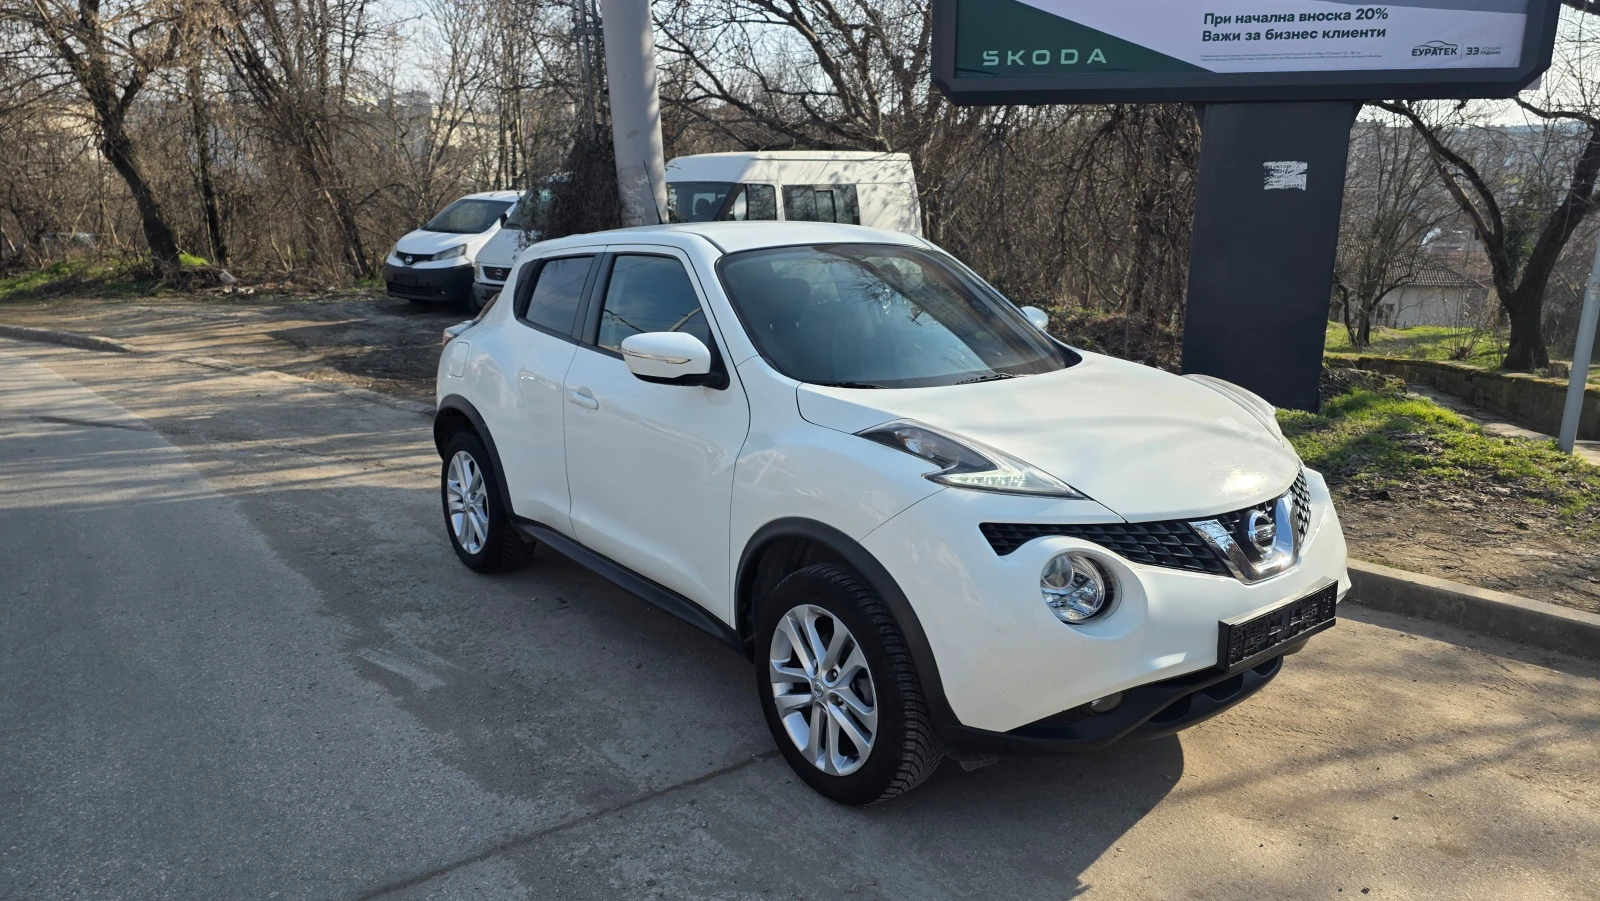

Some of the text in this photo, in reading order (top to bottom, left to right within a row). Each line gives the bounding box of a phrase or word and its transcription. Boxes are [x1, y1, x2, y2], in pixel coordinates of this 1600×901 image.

[1203, 7, 1389, 27] При начална вноска 20%
[1202, 28, 1386, 42] Важи за бизнес клиенти
[982, 48, 1107, 65] SKODA
[1466, 47, 1480, 56] 33
